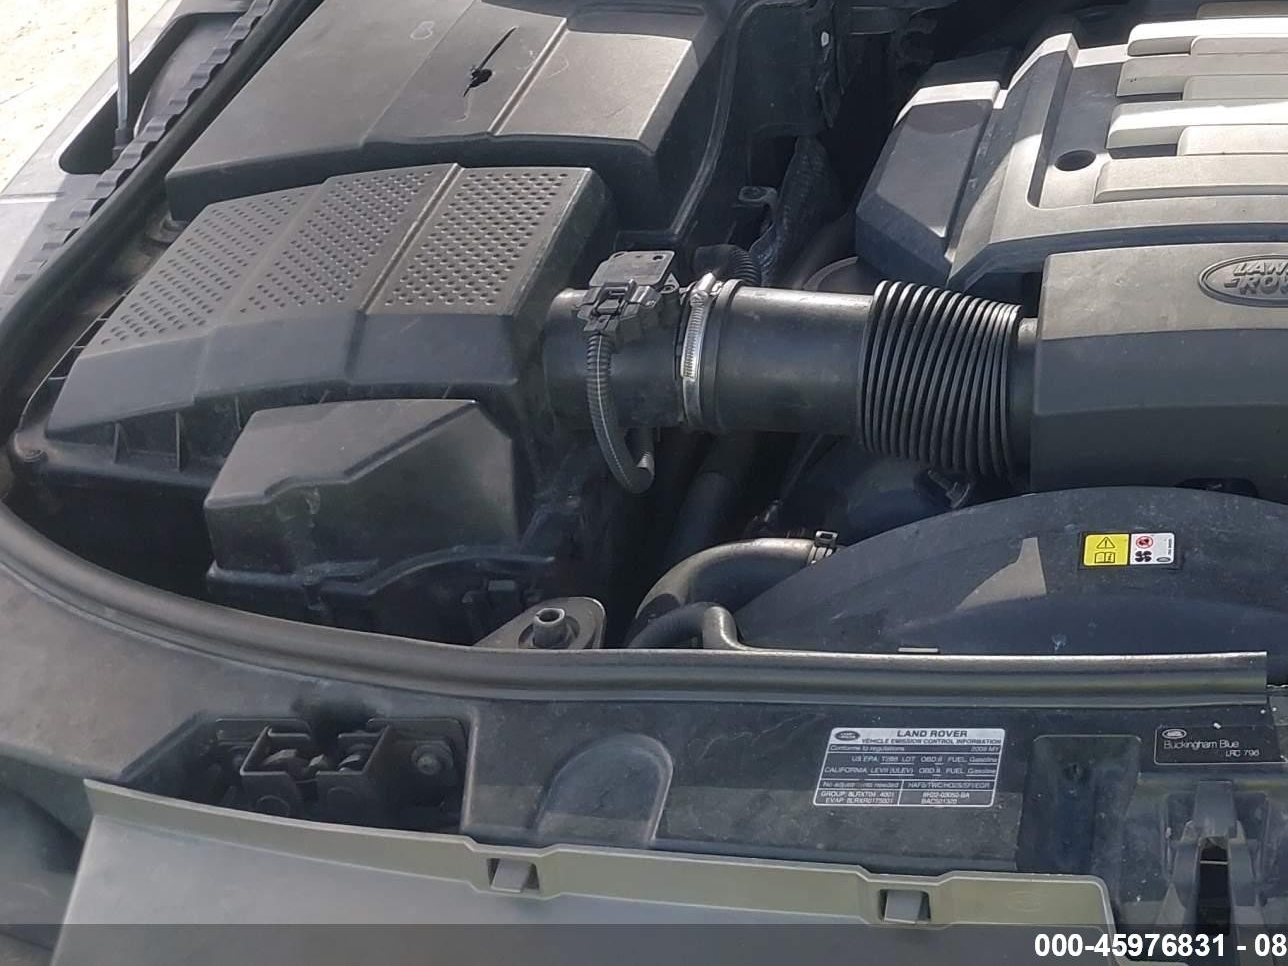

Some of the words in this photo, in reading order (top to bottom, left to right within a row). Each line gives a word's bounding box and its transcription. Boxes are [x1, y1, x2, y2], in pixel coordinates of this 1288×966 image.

[896, 730, 927, 738] LAND
[930, 730, 968, 738] ROVER
[1163, 740, 1217, 750] Buckingham
[1219, 739, 1240, 748] Blue
[1225, 749, 1241, 757] LRC
